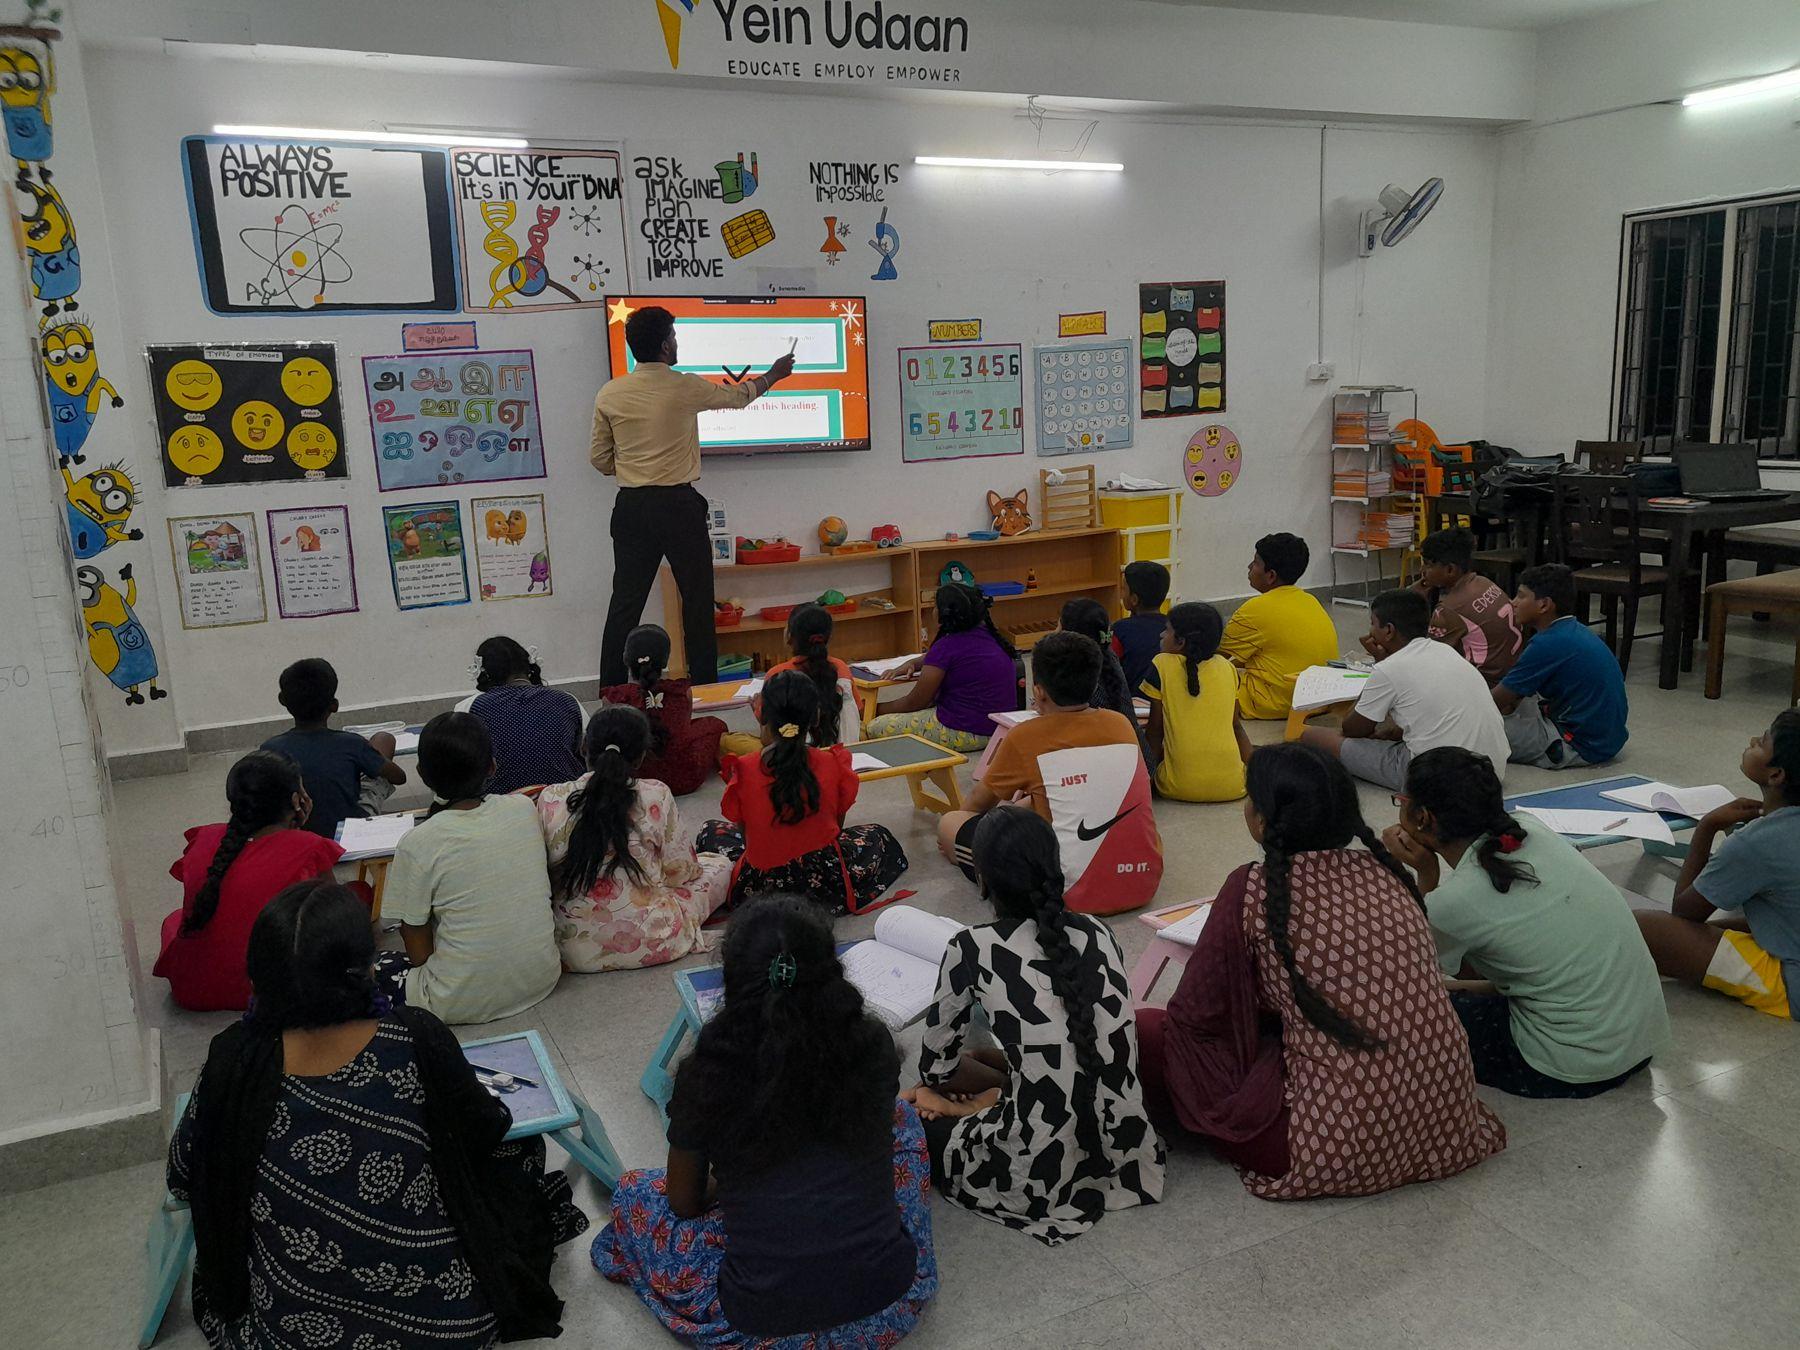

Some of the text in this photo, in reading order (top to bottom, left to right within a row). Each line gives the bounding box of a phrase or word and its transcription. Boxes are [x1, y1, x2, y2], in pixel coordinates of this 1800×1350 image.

[712, 0, 969, 52] Yein Udaan
[728, 60, 961, 83] EDUCATE EMPLOY EMPOWER
[220, 144, 334, 172] ALWAYS
[220, 168, 352, 198] POSITIVE
[810, 162, 900, 185] NOTHING IS
[461, 175, 622, 200] It's in Your DNA
[645, 178, 724, 200] IMAGINE
[640, 218, 710, 239] CREATE
[648, 257, 724, 281] IMPROVE
[932, 324, 978, 338] NUMBERS
[907, 354, 1018, 380] 0 1 2 3 4 5 6
[762, 402, 778, 410] this
[910, 408, 1023, 435] 6 5 4 3 2 1 0
[1060, 774, 1088, 787] JUST
[30, 815, 64, 838] 40
[1117, 864, 1134, 873] DO
